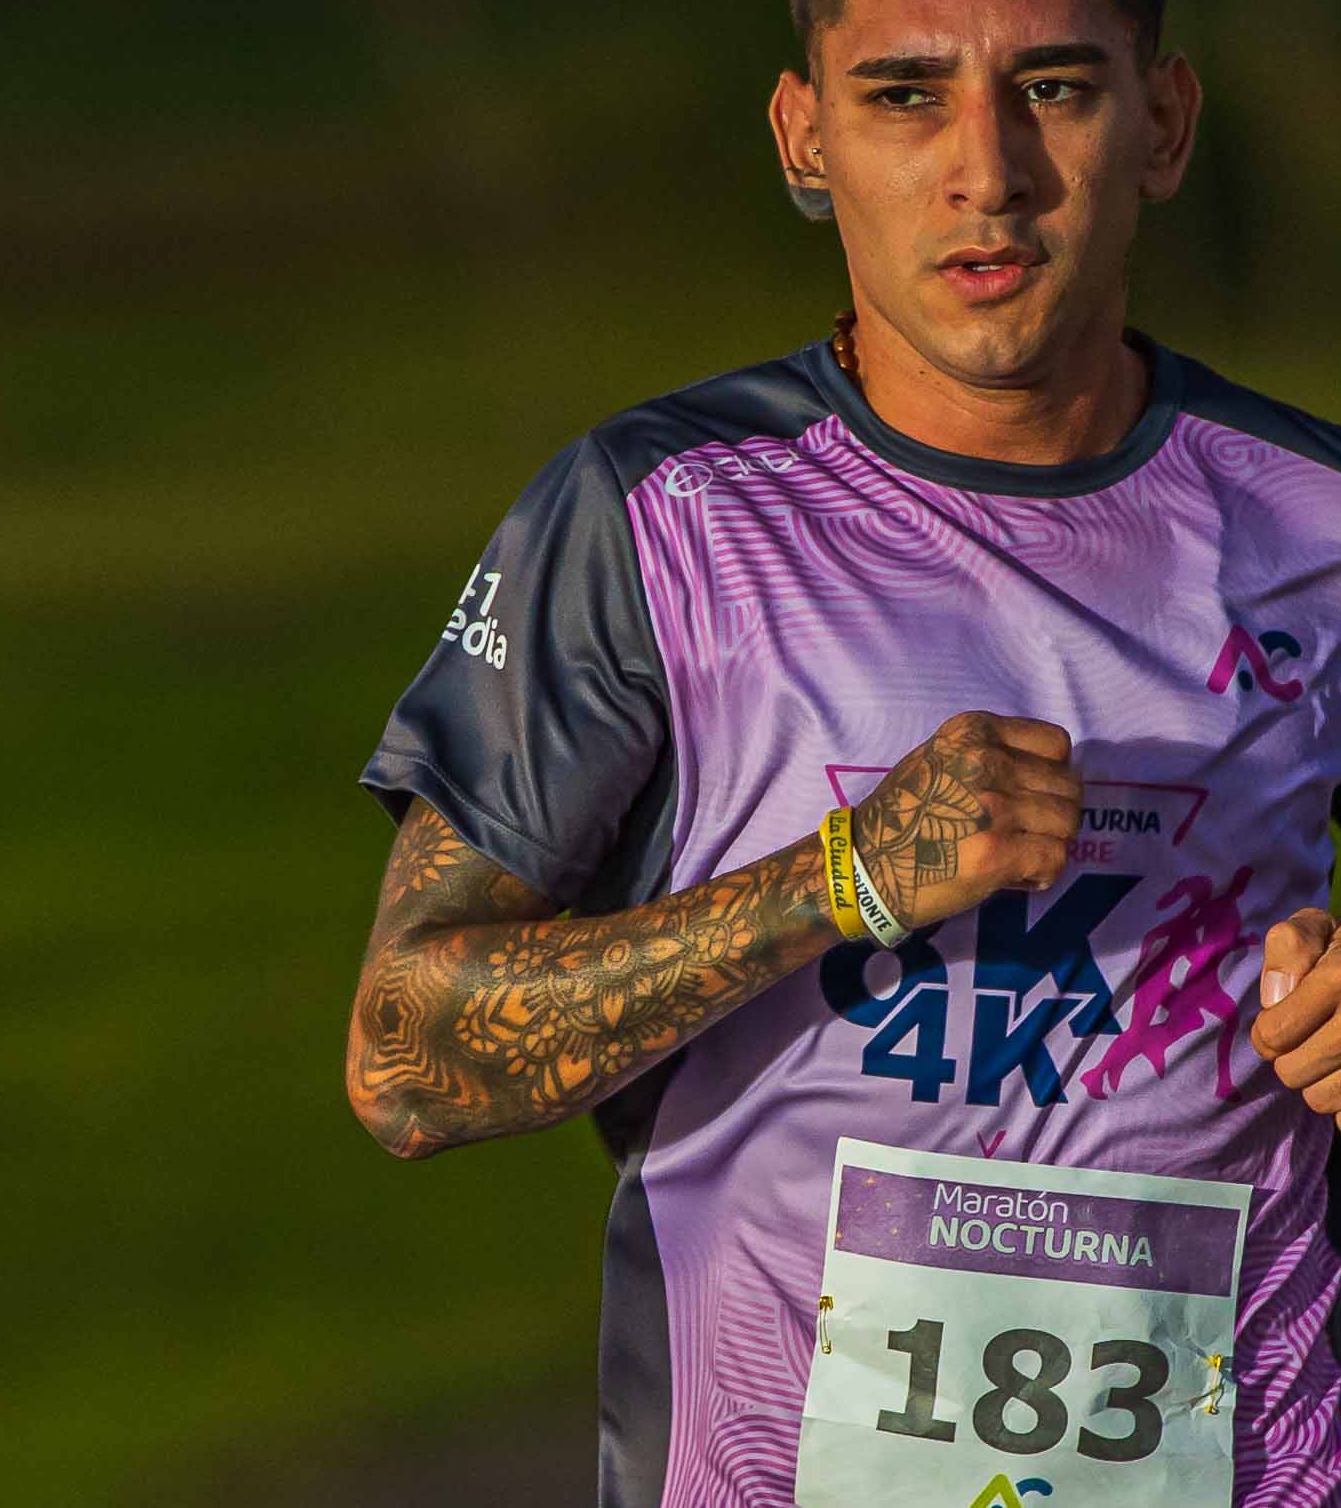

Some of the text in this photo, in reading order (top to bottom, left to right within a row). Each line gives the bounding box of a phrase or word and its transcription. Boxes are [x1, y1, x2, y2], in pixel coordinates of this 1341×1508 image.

[441, 607, 508, 671] edia
[1078, 806, 1161, 834] TURNA
[829, 835, 854, 910] Ciudad
[860, 988, 1085, 1108] 4K
[932, 1182, 1069, 1224] Maratón
[928, 1215, 1154, 1268] NOCTURNA
[876, 1318, 1170, 1462] 183
